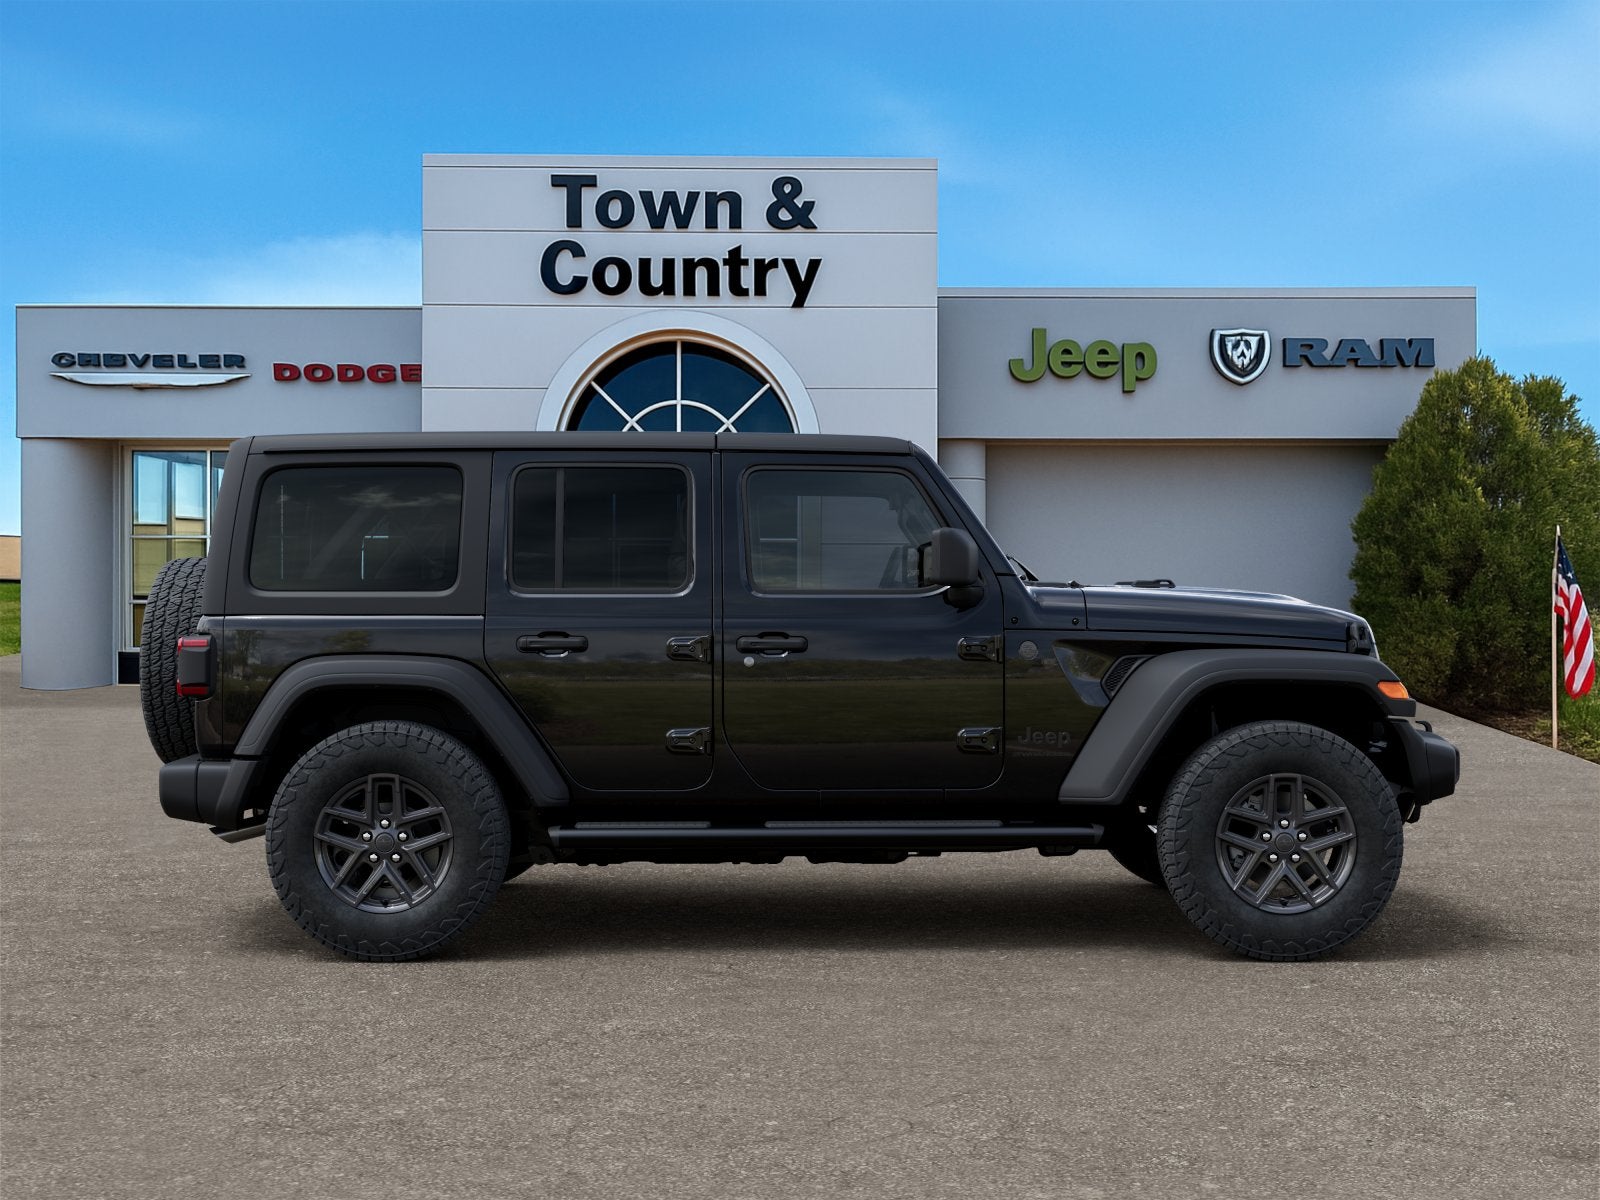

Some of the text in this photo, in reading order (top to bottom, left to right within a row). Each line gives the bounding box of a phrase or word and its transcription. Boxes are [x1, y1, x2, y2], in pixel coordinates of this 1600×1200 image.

[550, 174, 818, 230] Town &
[540, 239, 823, 308] Country
[272, 362, 422, 383] DODGE
[1009, 328, 1157, 393] Jeep
[1282, 337, 1436, 368] RAM
[1017, 726, 1072, 749] Jeep
